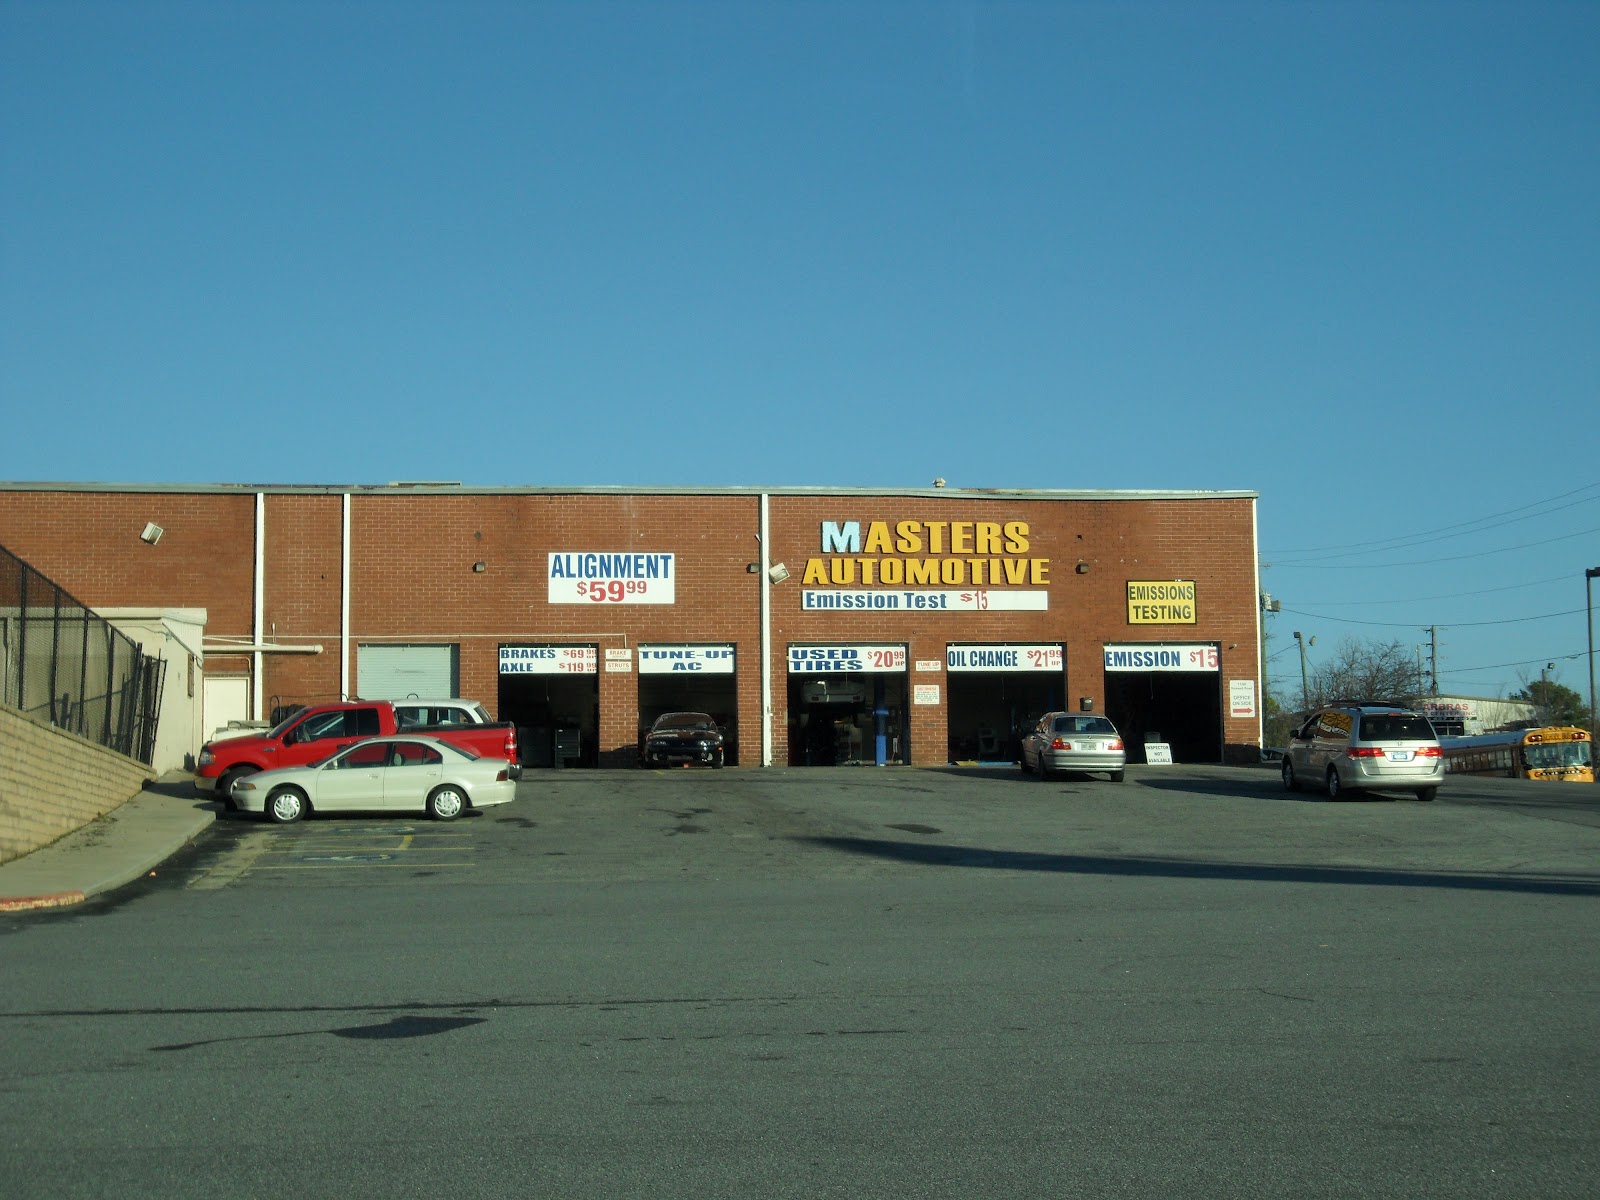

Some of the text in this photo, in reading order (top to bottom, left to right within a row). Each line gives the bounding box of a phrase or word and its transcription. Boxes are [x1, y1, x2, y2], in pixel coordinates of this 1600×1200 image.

[820, 520, 1030, 554] MASTERS
[551, 553, 672, 579] ALIGNMENT
[802, 557, 1050, 585] AUTOMOTIVE
[805, 591, 899, 609] Emission
[904, 592, 947, 609] Test
[1129, 586, 1194, 600] EMISSIONS
[1133, 605, 1192, 619] TESTING
[500, 649, 556, 659] BRAKES
[640, 650, 734, 659] TUNE-UP
[792, 649, 858, 659] USED
[947, 650, 967, 667] OIL
[969, 650, 1018, 667] CHANGE
[1105, 649, 1219, 668] EMISSION $15
[500, 662, 534, 672] AXLE
[672, 661, 702, 671] AC
[790, 660, 863, 671] TIRES
